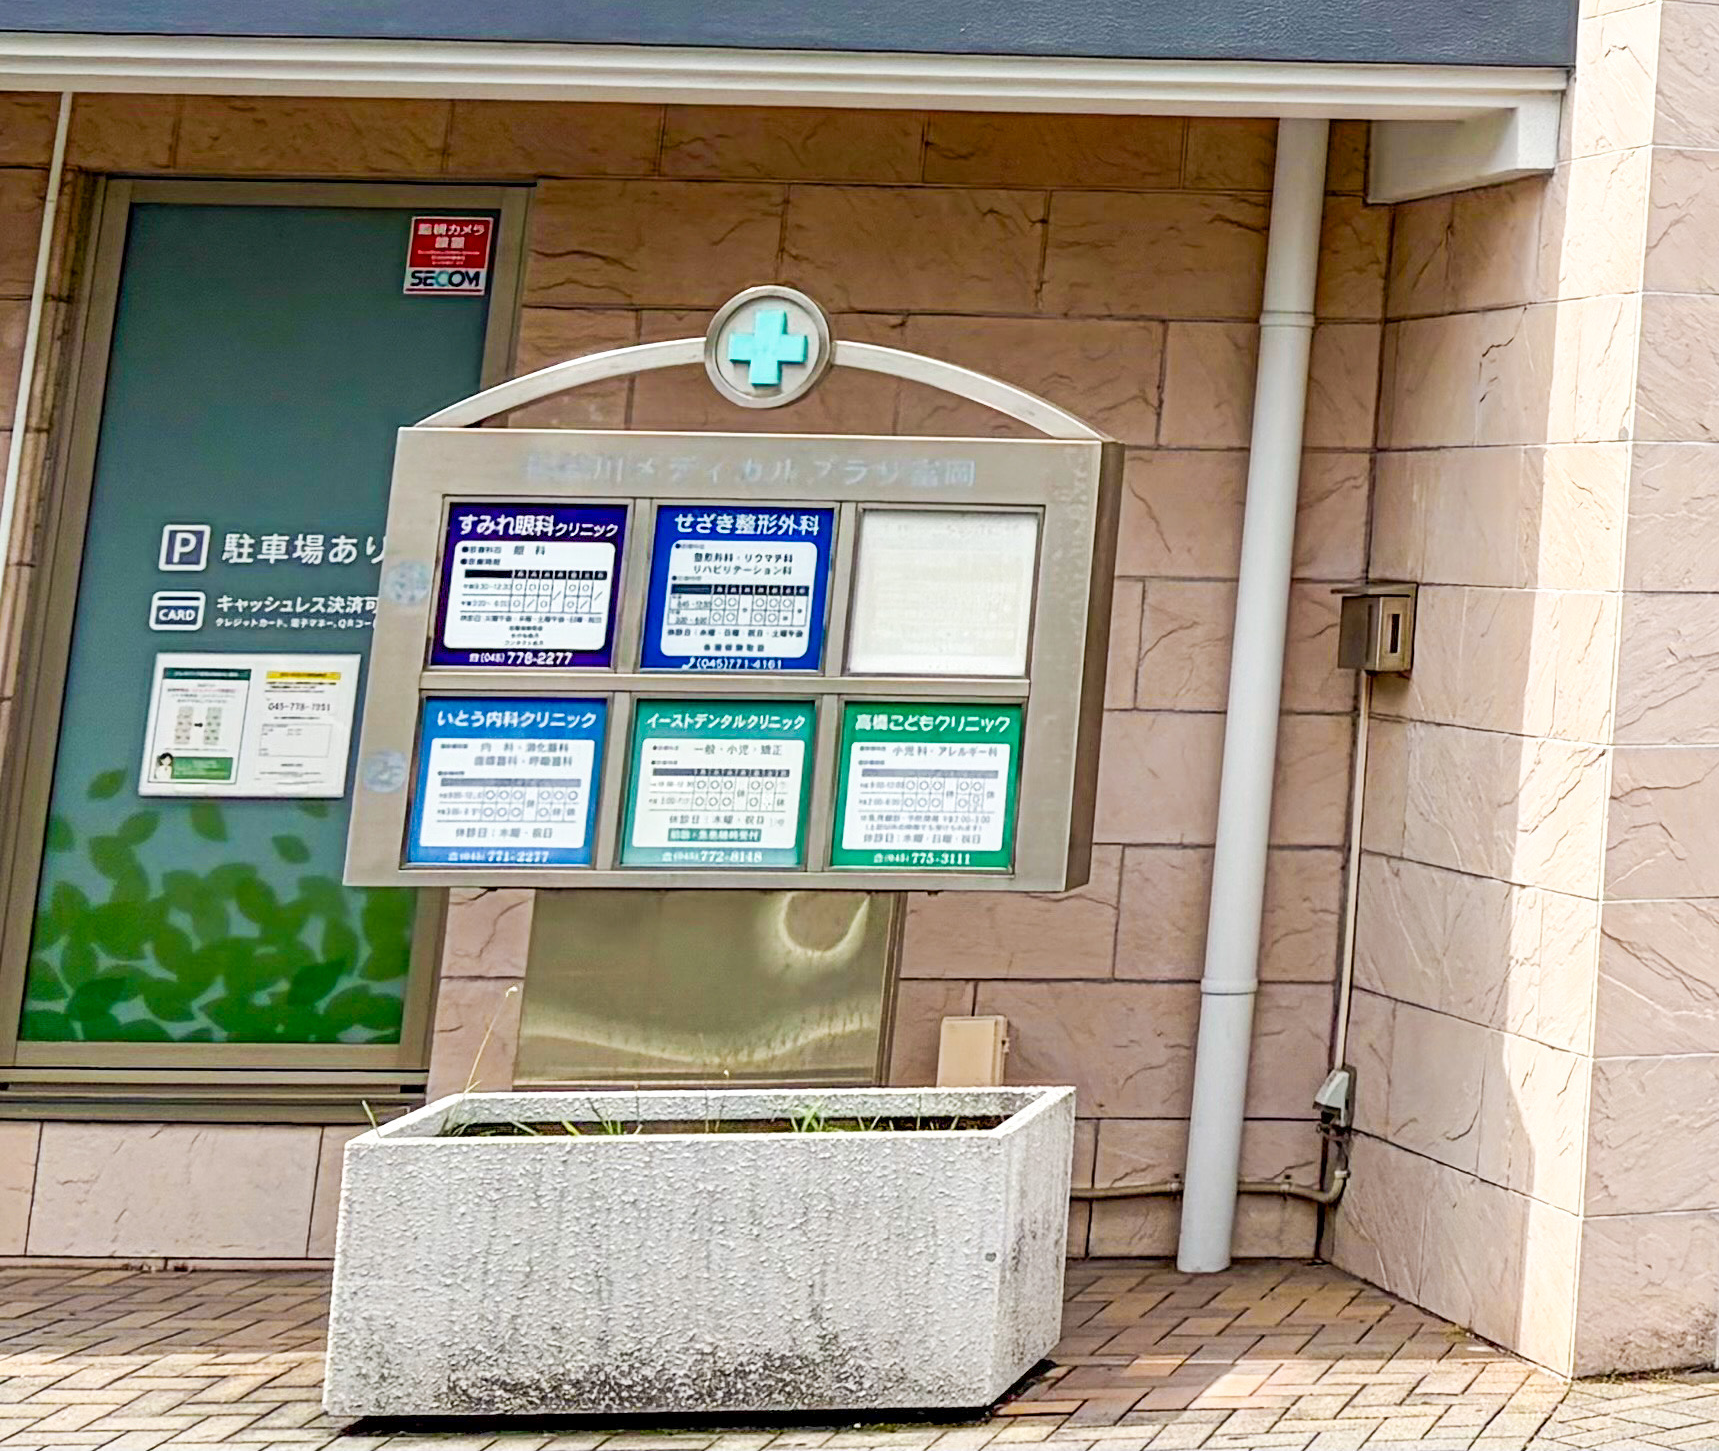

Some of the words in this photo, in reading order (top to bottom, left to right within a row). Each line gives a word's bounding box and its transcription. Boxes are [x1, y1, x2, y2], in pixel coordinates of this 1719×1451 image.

[410, 270, 481, 287] SECOM
[458, 514, 619, 537] すみれ眼科クリニック
[674, 513, 819, 536] せざき整形外科
[172, 532, 198, 564] P
[221, 533, 386, 565] 駐車場あり
[216, 595, 379, 613] キャッシュレス決済可
[158, 609, 196, 621] CARD
[437, 710, 597, 729] いとう内科クリニック
[647, 713, 806, 730] イーストデンタルクリニック
[855, 714, 1011, 732] 高橋こどもクリニック
